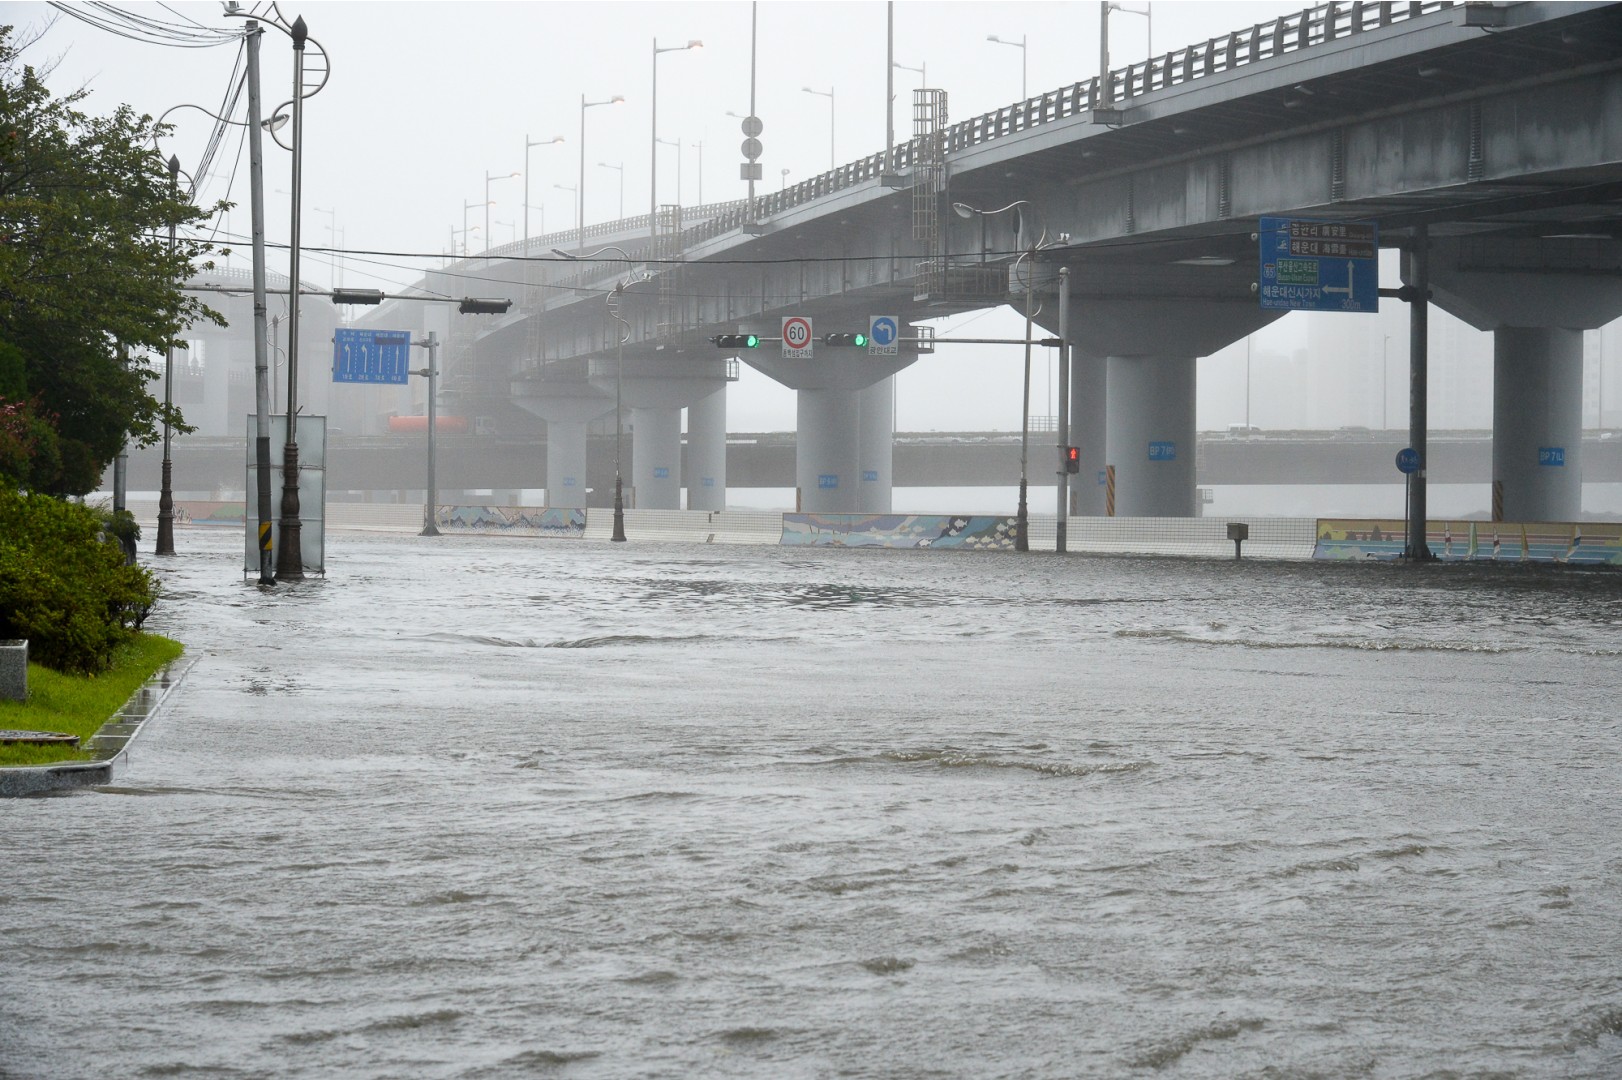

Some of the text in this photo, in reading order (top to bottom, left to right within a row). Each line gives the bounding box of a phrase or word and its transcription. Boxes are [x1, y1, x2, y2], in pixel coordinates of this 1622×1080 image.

[1292, 223, 1317, 237] 광안리
[1292, 241, 1318, 254] 해운대
[1278, 261, 1318, 272] 부산울산고속도로
[1263, 285, 1321, 299] 해운대신시가지
[789, 326, 805, 341] 60
[869, 346, 897, 355] 광안대교
